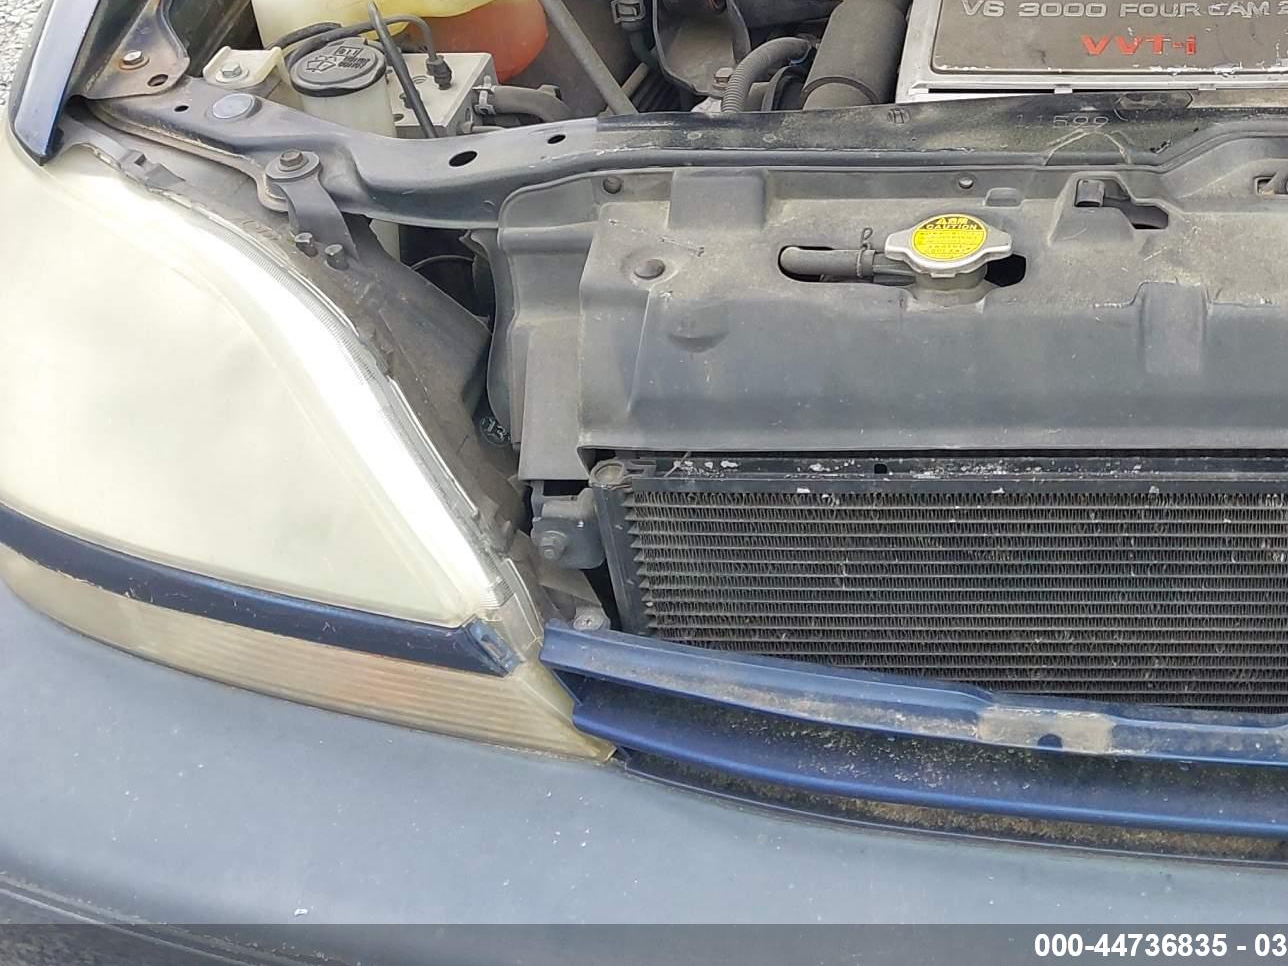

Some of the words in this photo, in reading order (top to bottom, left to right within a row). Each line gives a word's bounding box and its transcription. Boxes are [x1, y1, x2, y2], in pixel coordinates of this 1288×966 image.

[962, 0, 1005, 17] V6
[1018, 1, 1107, 18] 3000
[1119, 1, 1201, 18] FOUR
[1207, 0, 1271, 19] CAM
[1081, 35, 1197, 55] VVT-i
